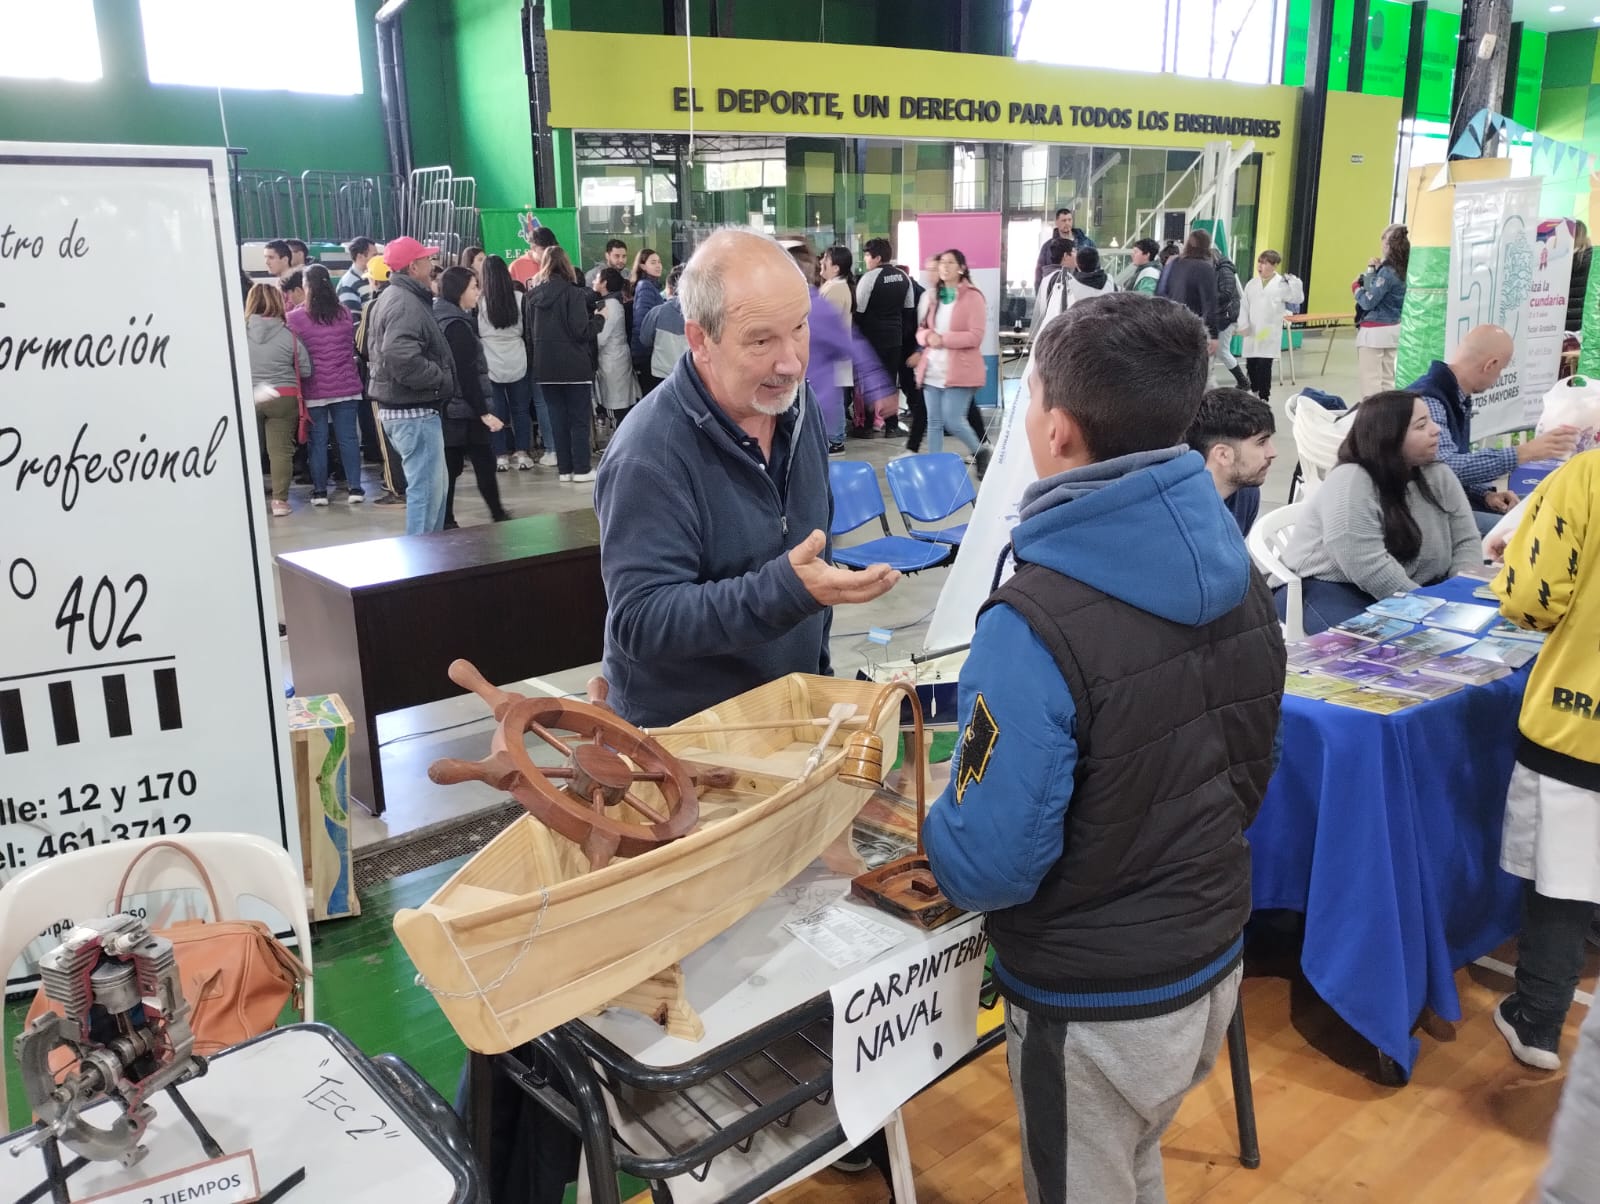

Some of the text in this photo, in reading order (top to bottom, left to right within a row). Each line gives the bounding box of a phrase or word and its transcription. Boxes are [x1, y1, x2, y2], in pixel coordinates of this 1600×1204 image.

[673, 87, 1281, 138] EL DEPORTE, UN DERECHO PARA TODOS LOS ENSENADENSES
[59, 218, 90, 258] de
[0, 306, 170, 371] ormación
[0, 415, 229, 512] Profesional
[55, 573, 148, 655] 402
[57, 783, 102, 815] 12
[110, 785, 127, 813] y
[137, 769, 198, 803] 170
[36, 813, 193, 859] 461-3712
[856, 990, 943, 1073] NAVAL
[160, 1173, 242, 1204] TIEMPOS
